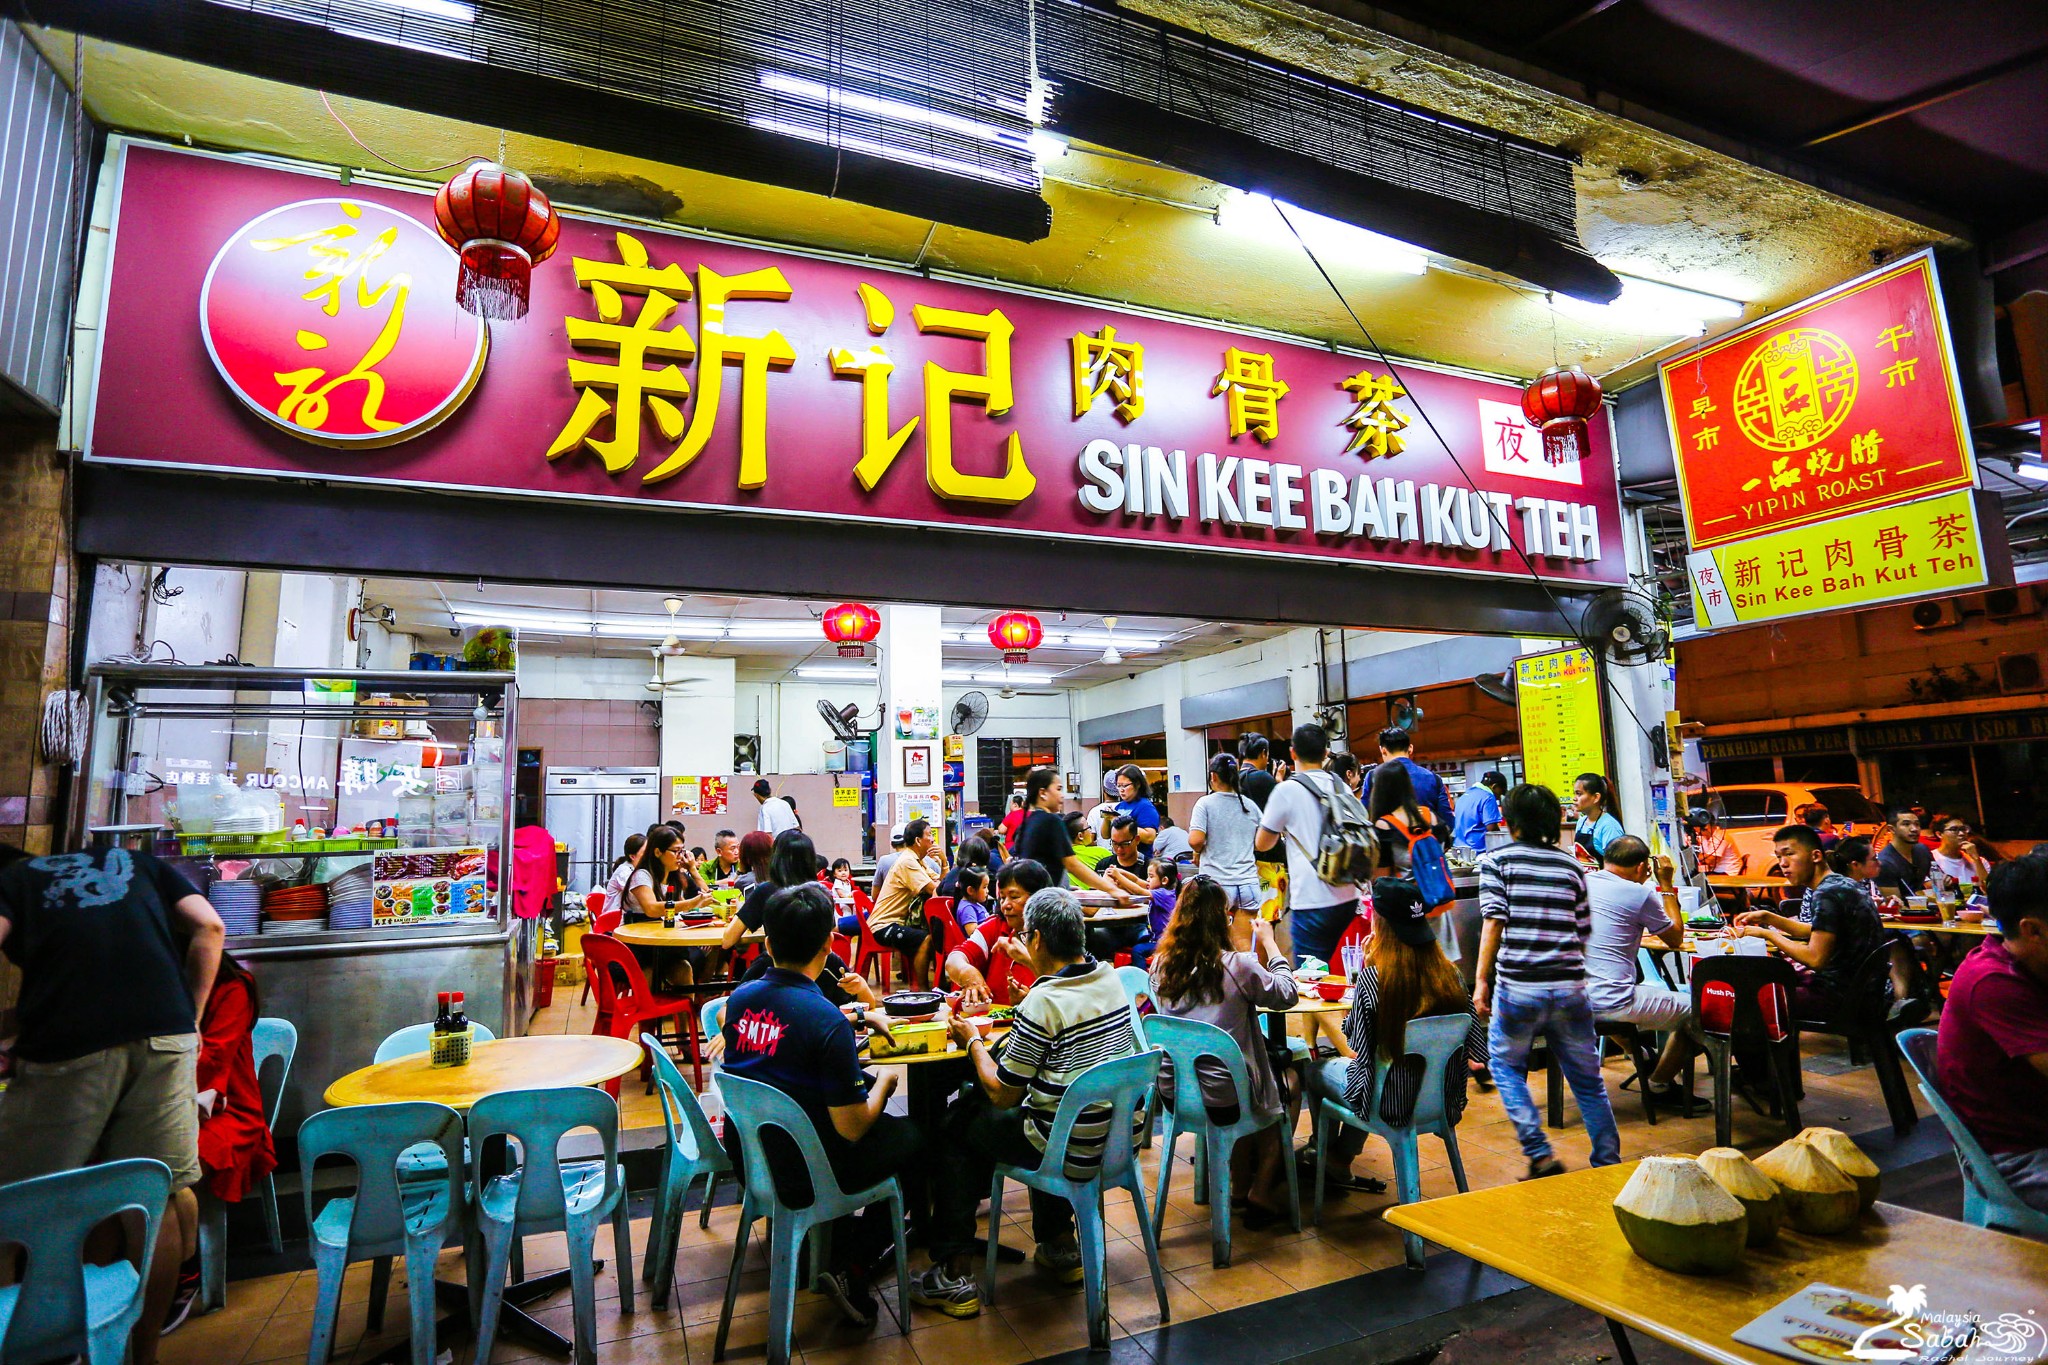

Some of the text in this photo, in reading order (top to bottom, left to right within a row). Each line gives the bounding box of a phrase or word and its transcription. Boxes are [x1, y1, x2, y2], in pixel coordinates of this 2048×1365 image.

[547, 231, 1412, 505] 新记 肉骨茶
[1876, 325, 1919, 388] 午市
[1689, 396, 1720, 451] 早市
[1741, 429, 1884, 492] 一品烧腊
[1078, 439, 1601, 563] SIN KEE BAH KUT TEH
[1742, 468, 1886, 520] YIPIN ROAST
[1734, 512, 1968, 589] 新记肉骨茶
[1698, 567, 1723, 607] 夜市
[1736, 552, 1974, 609] Sin Kee Bah Kut Teh
[1706, 987, 1724, 996] Hush
[738, 1018, 780, 1045] SMTM
